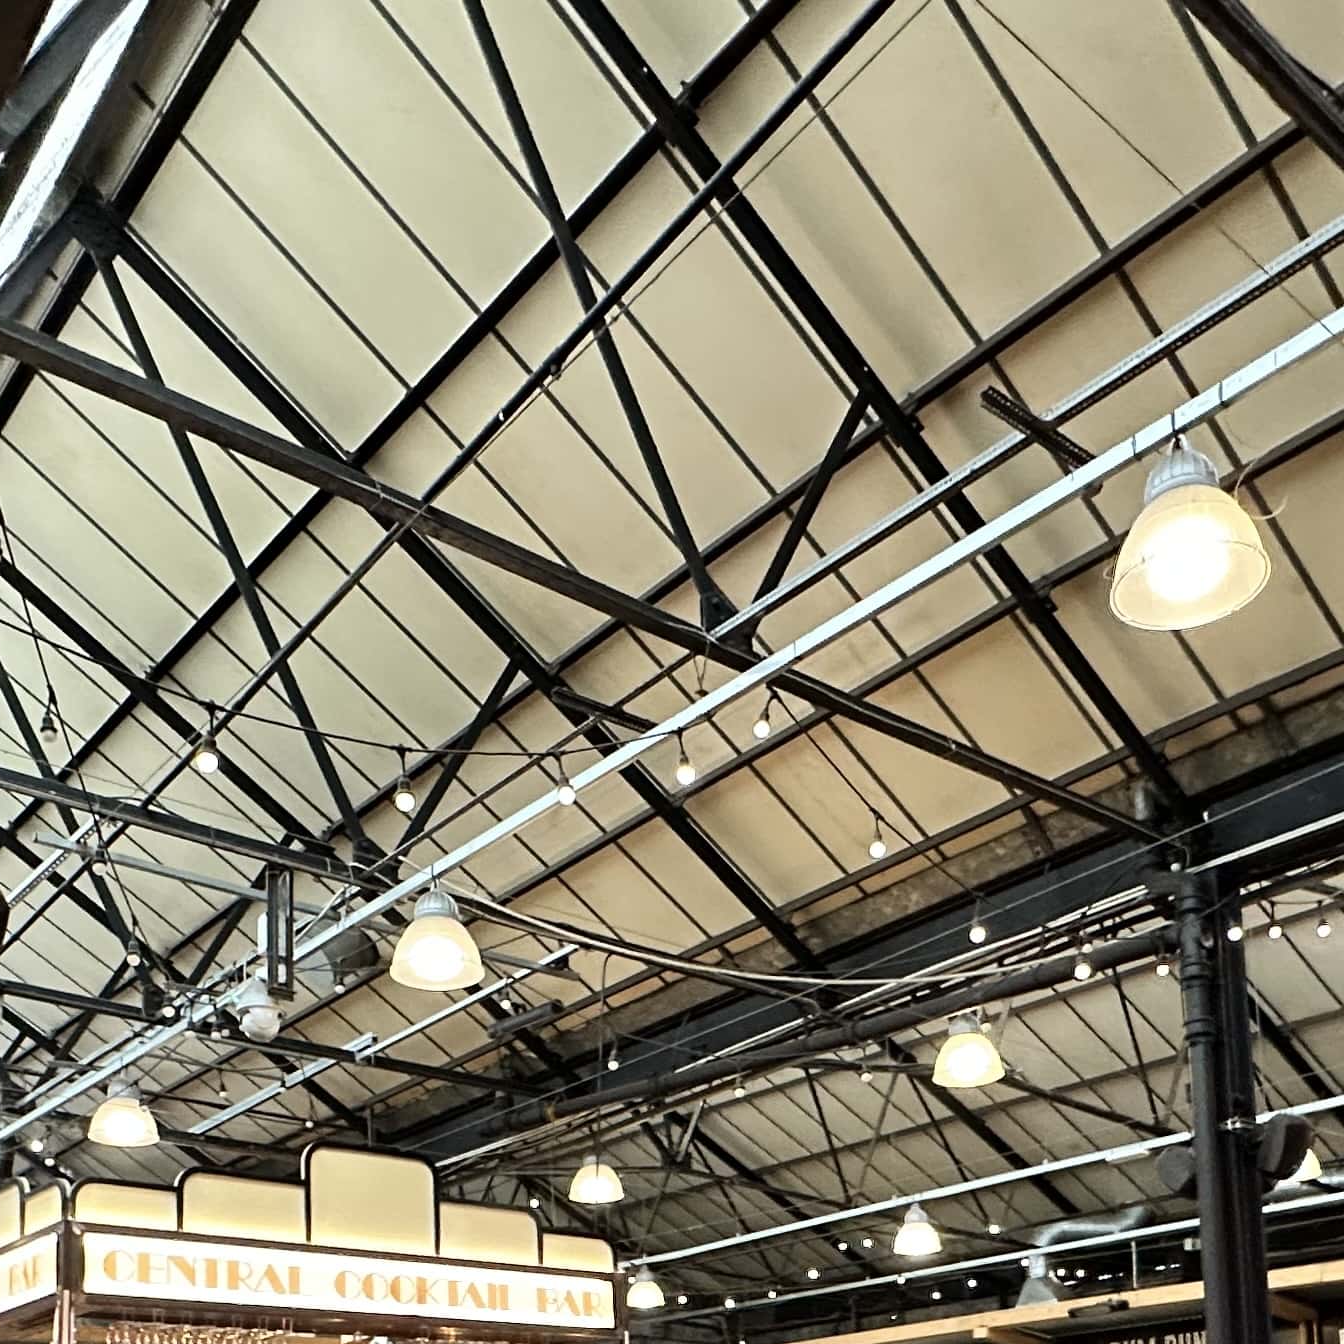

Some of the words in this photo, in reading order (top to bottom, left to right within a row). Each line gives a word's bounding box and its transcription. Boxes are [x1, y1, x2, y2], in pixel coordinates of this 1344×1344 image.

[103, 1250, 313, 1297] CENTRAL
[335, 1269, 512, 1311] COCKTAIL
[536, 1286, 608, 1318] BAR
